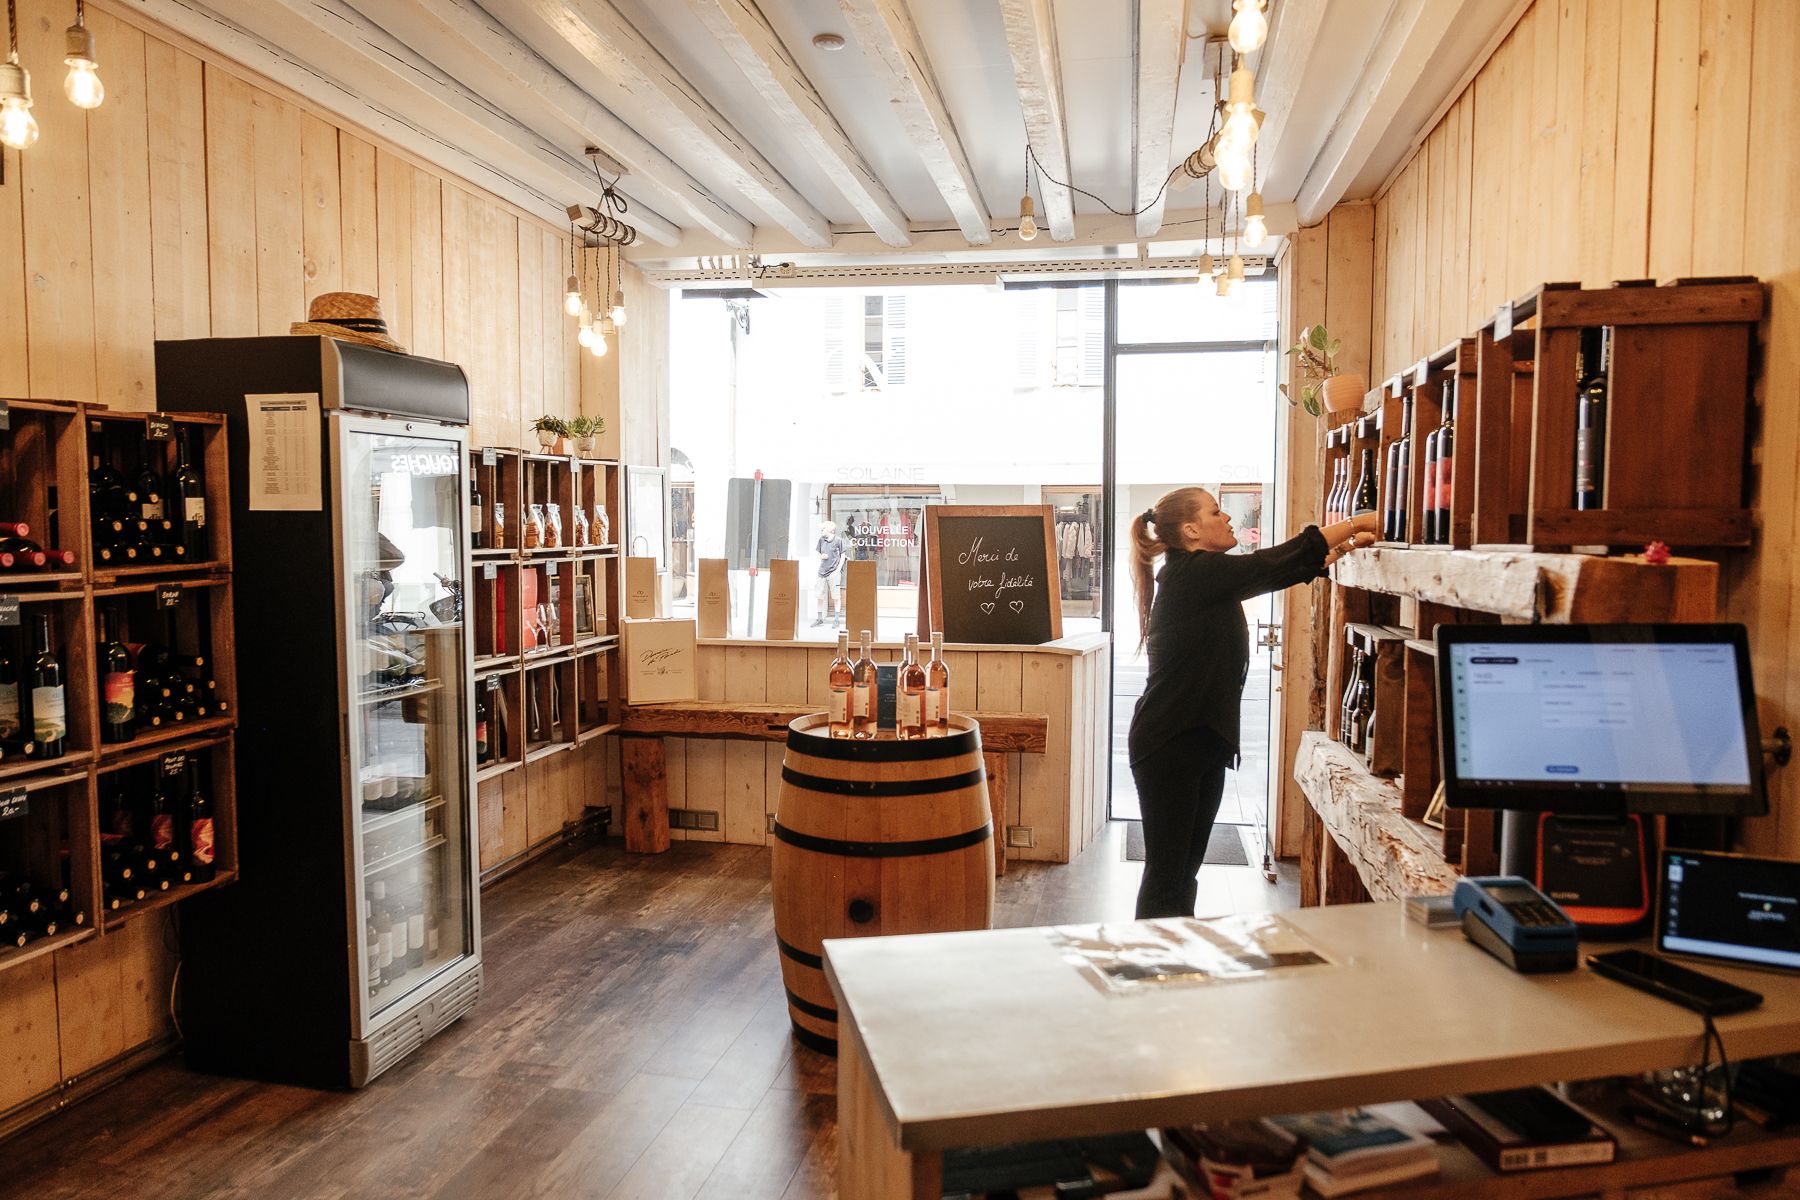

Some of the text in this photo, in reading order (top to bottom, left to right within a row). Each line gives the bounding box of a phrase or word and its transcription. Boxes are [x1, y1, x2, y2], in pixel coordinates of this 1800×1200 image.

[837, 467, 925, 481] SOILAINE
[855, 526, 909, 535] NOUVELLE
[849, 538, 915, 548] COLLECTION
[958, 536, 1019, 567] Merci de
[968, 575, 995, 591] votre
